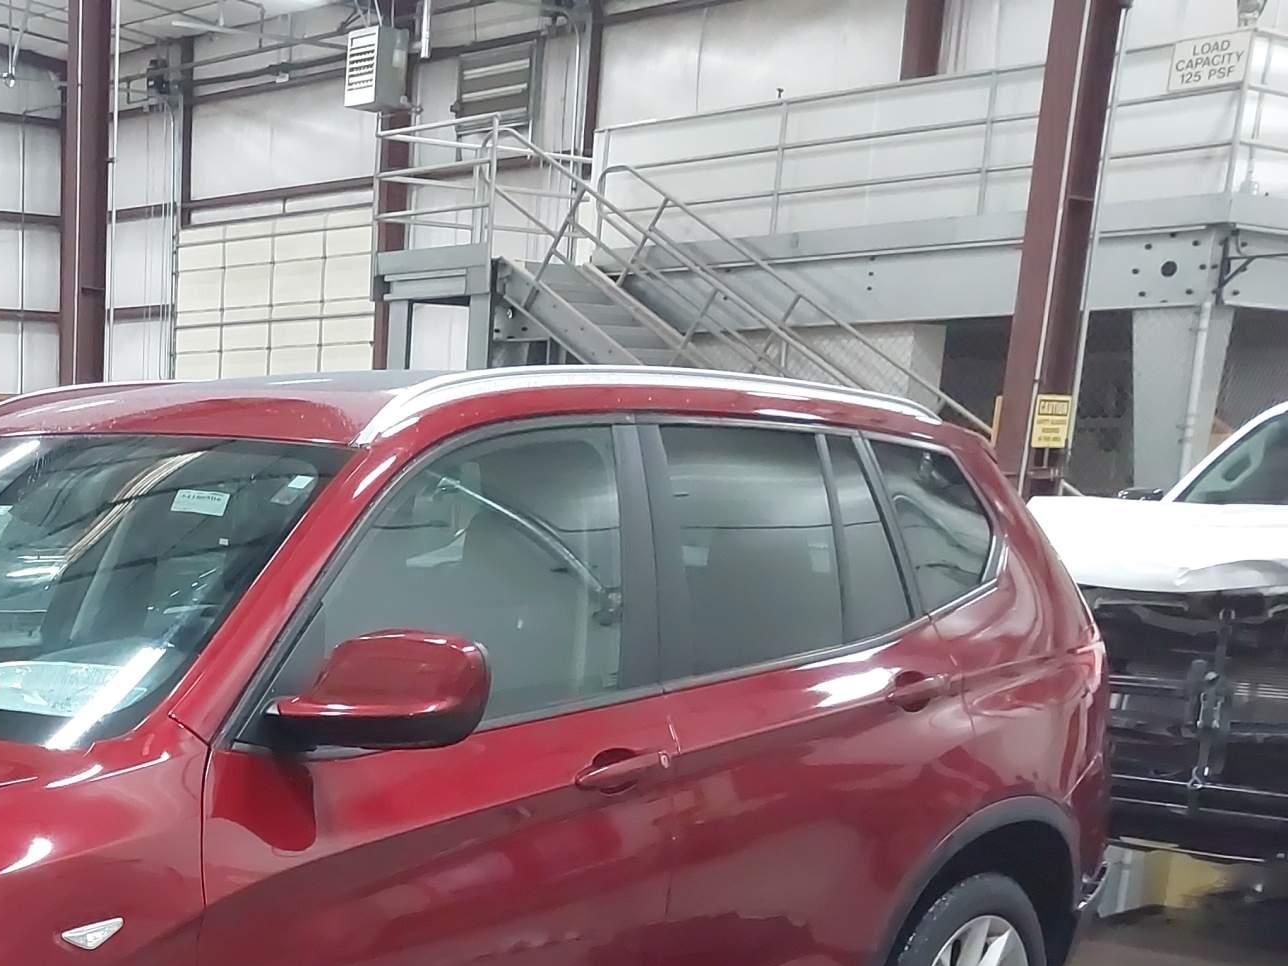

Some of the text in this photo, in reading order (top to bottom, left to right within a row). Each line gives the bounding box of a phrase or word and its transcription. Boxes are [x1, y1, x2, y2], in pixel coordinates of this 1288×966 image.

[1192, 40, 1231, 56] LOAD
[1175, 50, 1244, 72] CAPACITY
[1180, 65, 1236, 84] 125 PSF
